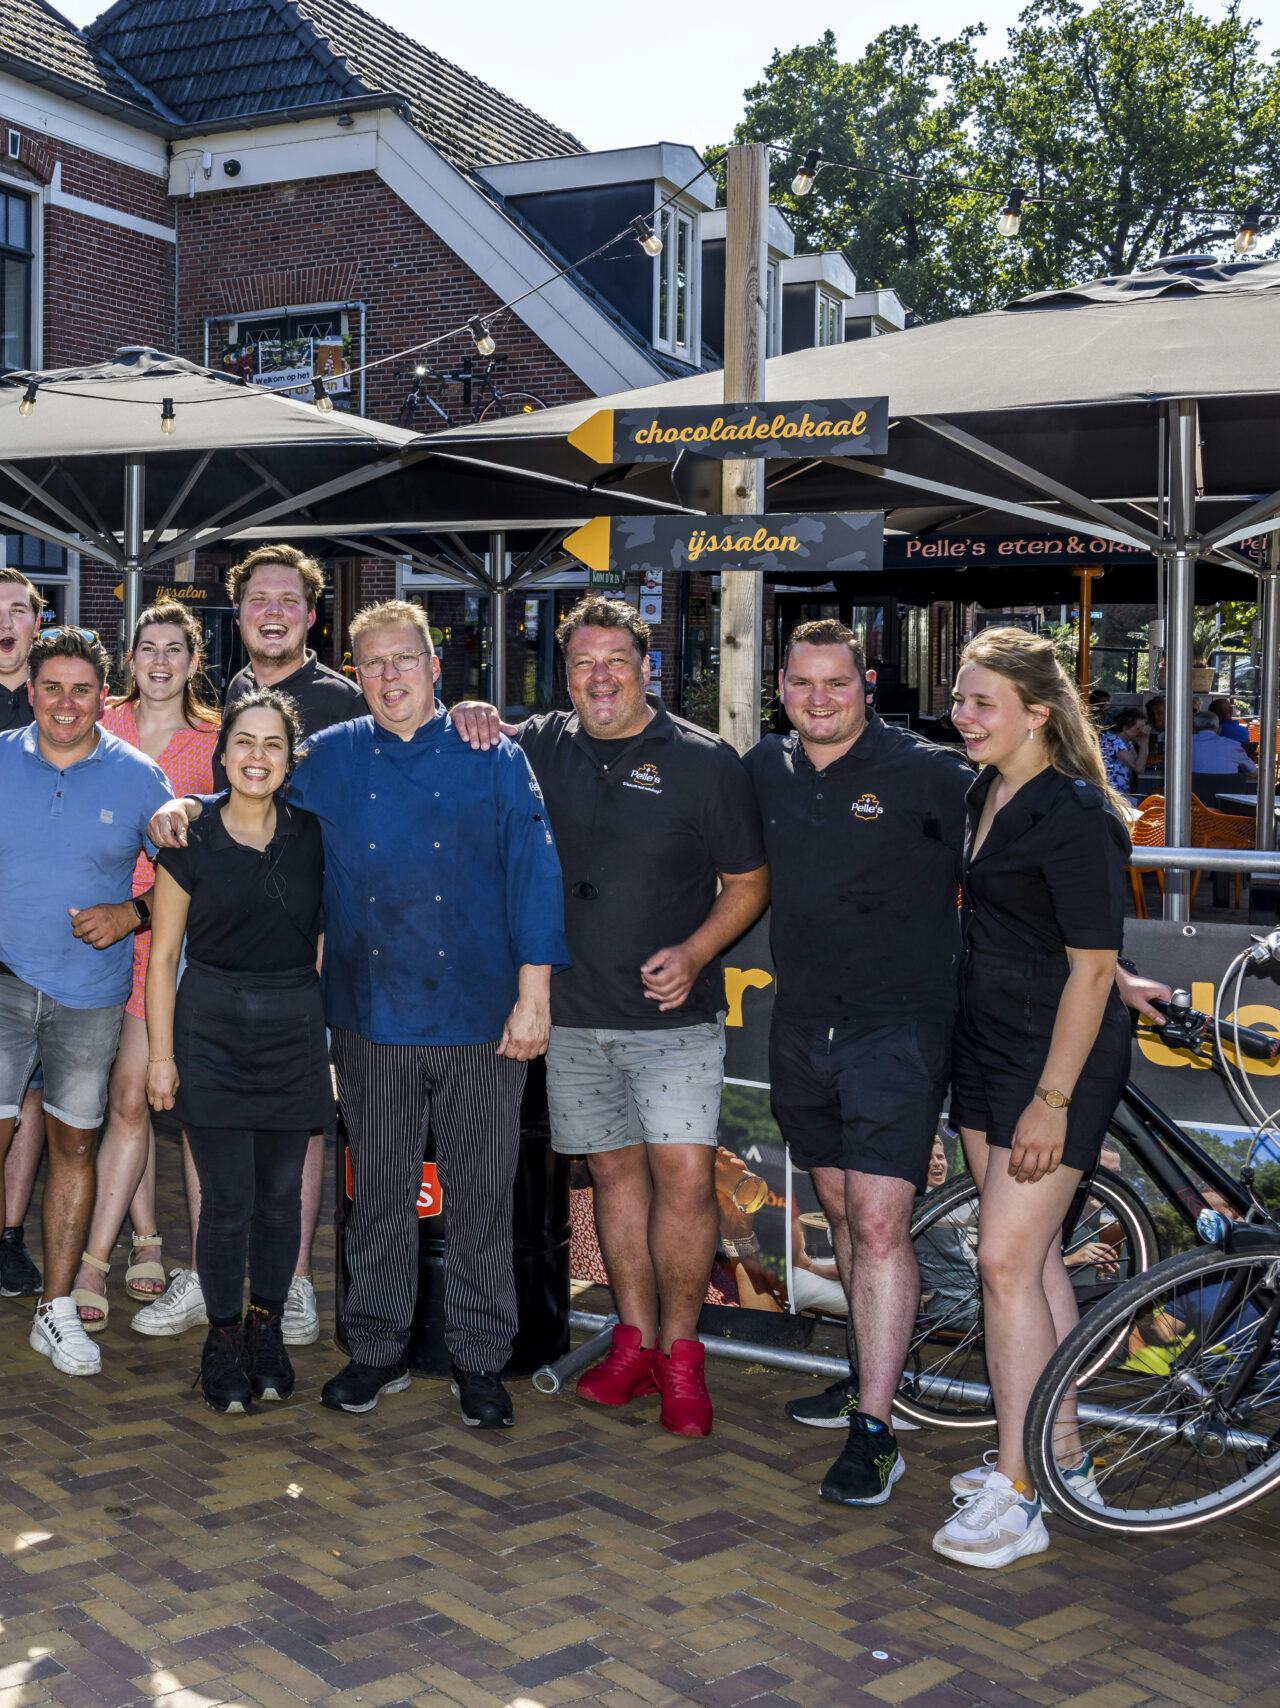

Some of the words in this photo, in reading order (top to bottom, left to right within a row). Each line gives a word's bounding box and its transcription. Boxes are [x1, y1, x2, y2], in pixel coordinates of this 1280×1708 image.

[255, 375, 285, 385] Welkom
[286, 373, 297, 382] op
[297, 371, 310, 380] het
[634, 410, 867, 445] chocoladelokaal
[687, 527, 801, 561] ijssalon
[906, 538, 986, 558] Pelle's
[630, 769, 661, 784] Pelle's
[851, 802, 884, 814] Pelle's
